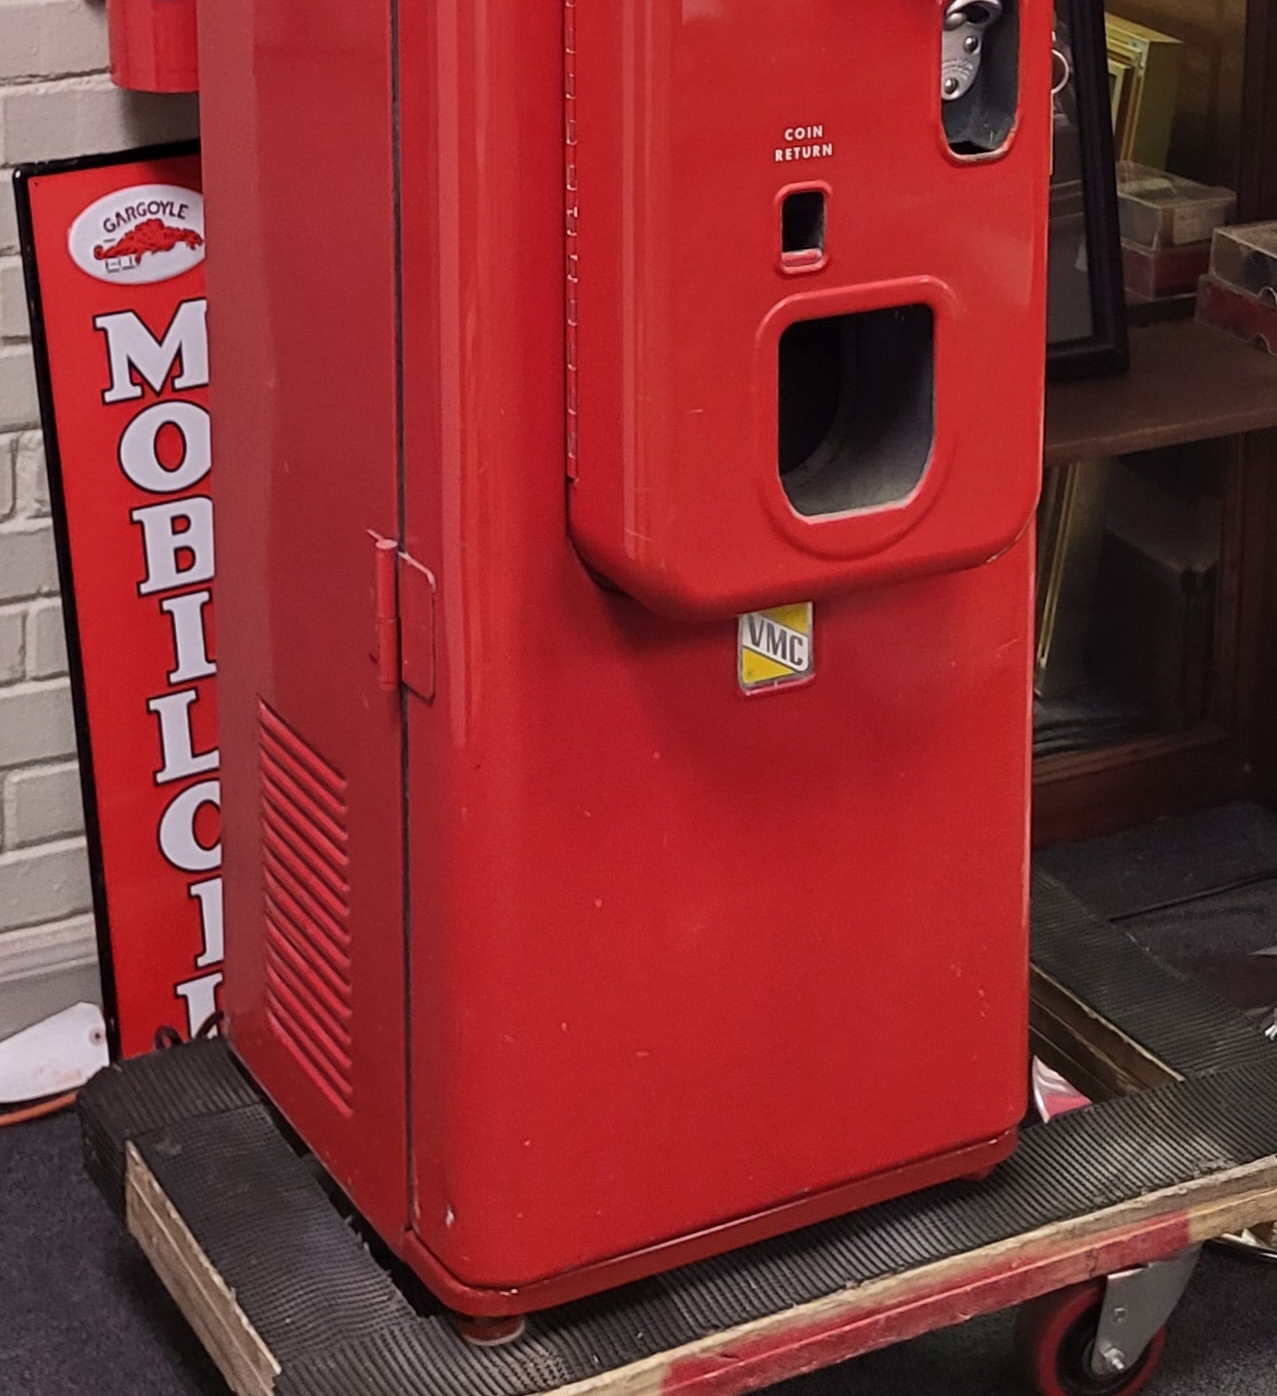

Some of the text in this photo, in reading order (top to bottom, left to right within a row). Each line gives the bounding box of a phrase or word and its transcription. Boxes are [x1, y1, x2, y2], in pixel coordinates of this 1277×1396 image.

[784, 125, 823, 141] COIN
[775, 143, 833, 162] RETURN
[103, 200, 190, 233] GARGOYLE
[748, 614, 803, 666] VMC
